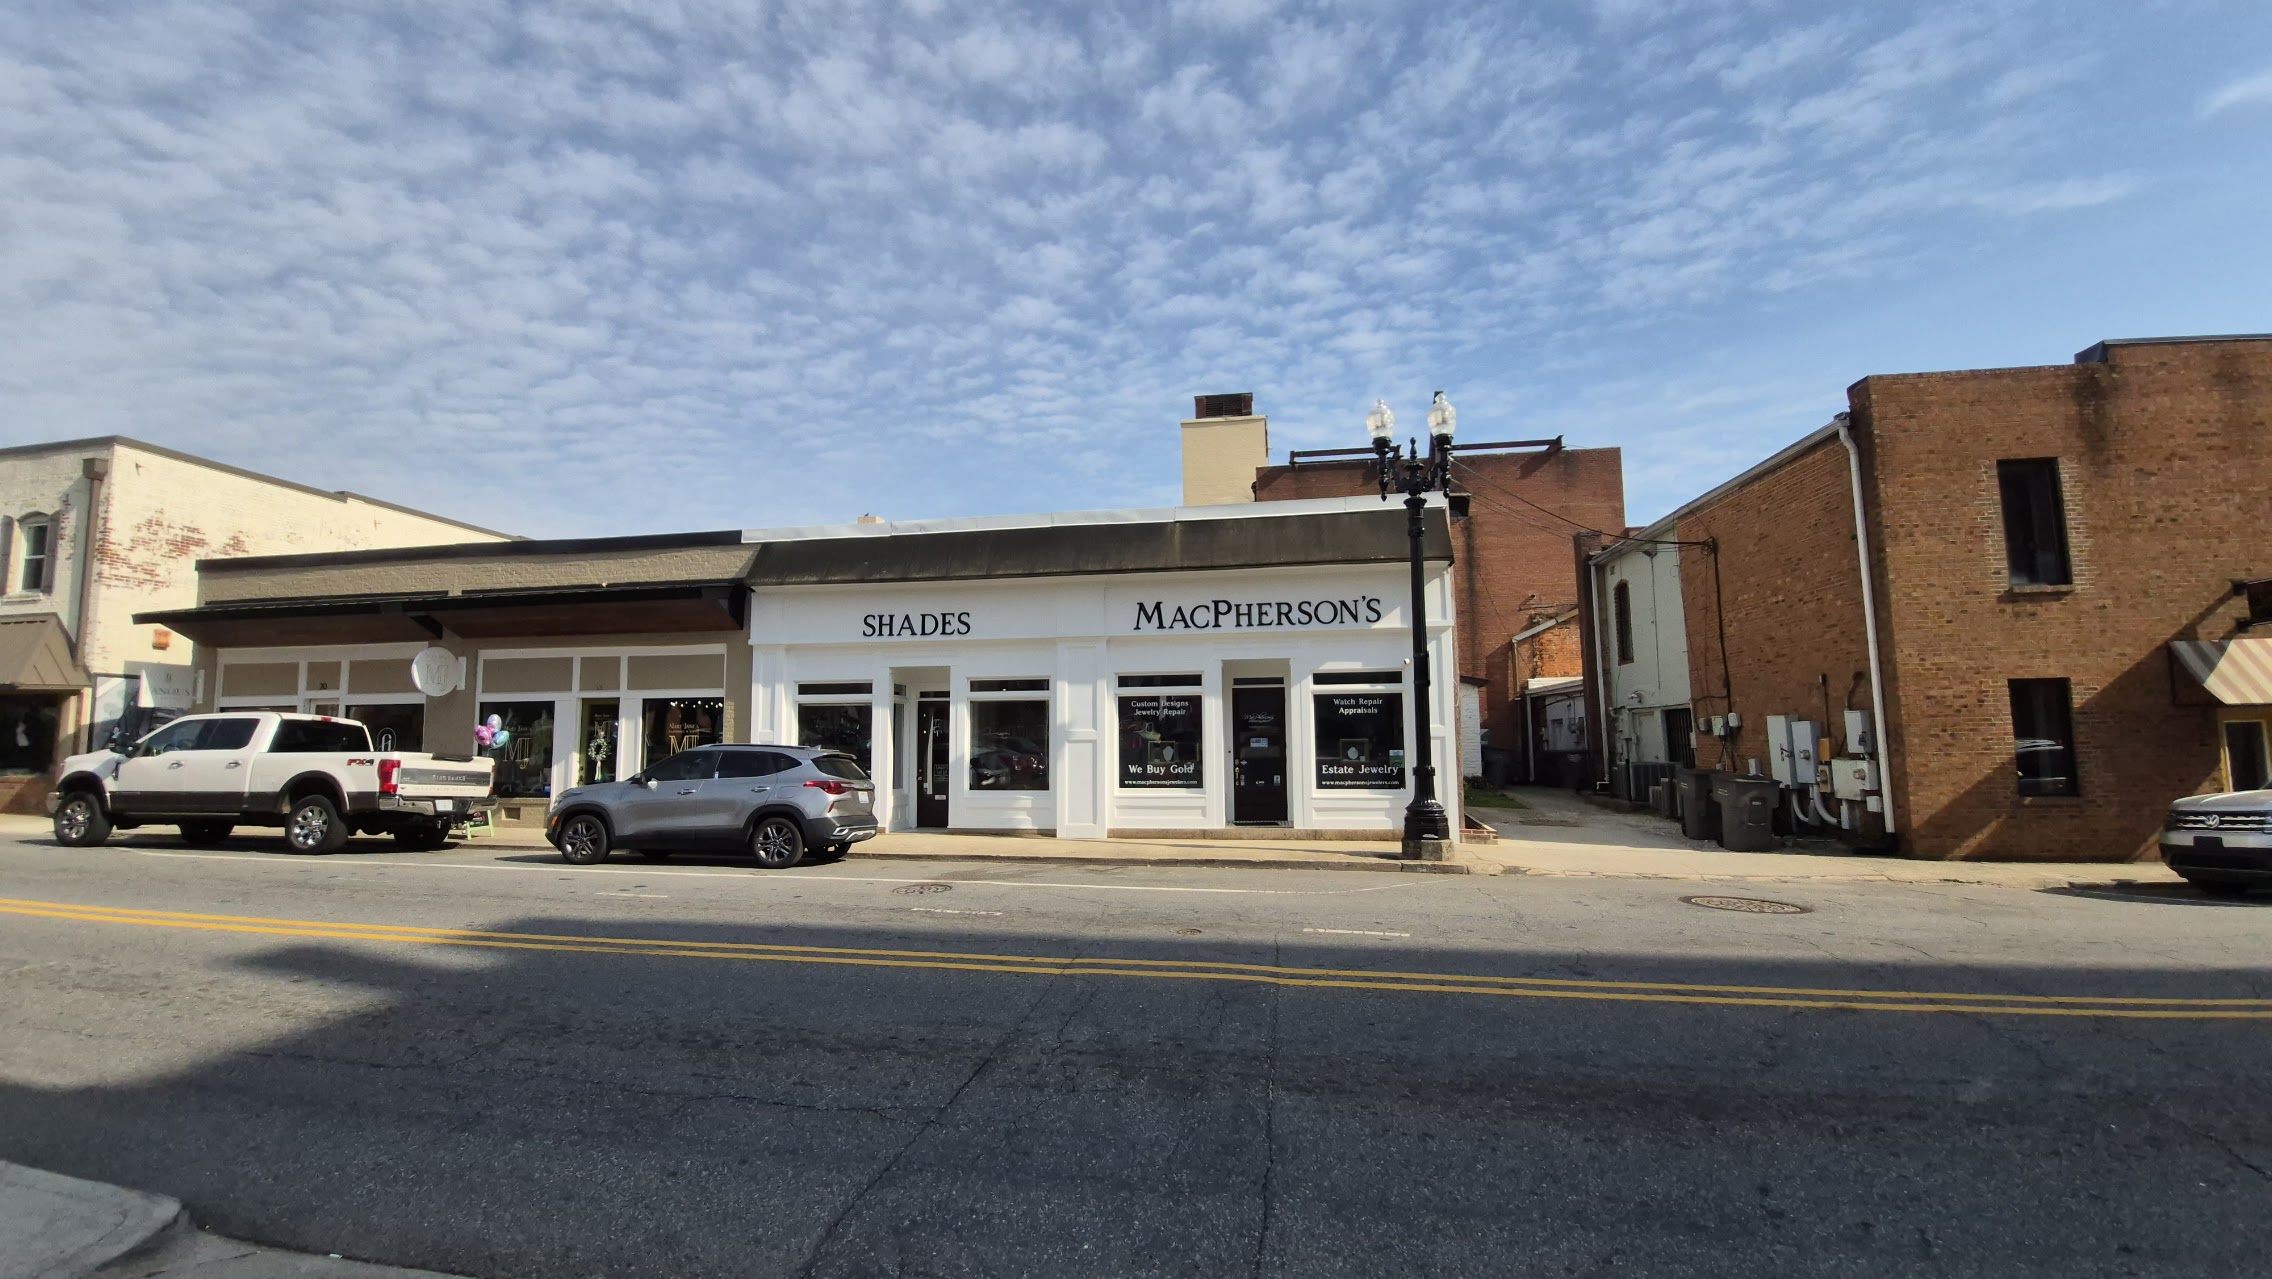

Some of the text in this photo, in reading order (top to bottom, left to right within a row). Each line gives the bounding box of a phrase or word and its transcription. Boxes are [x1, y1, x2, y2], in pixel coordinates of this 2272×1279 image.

[1133, 595, 1382, 631] MACPHERSON'S
[862, 612, 971, 637] SHADES
[1161, 700, 1189, 709] Designs
[1359, 698, 1383, 706] Repair
[1134, 708, 1187, 716] Jewelry Repair
[1338, 706, 1378, 716] Appraisals
[347, 758, 375, 767] FX4
[1128, 763, 1194, 776] We Buy Gold
[1321, 764, 1399, 776] Estate Jewelry
